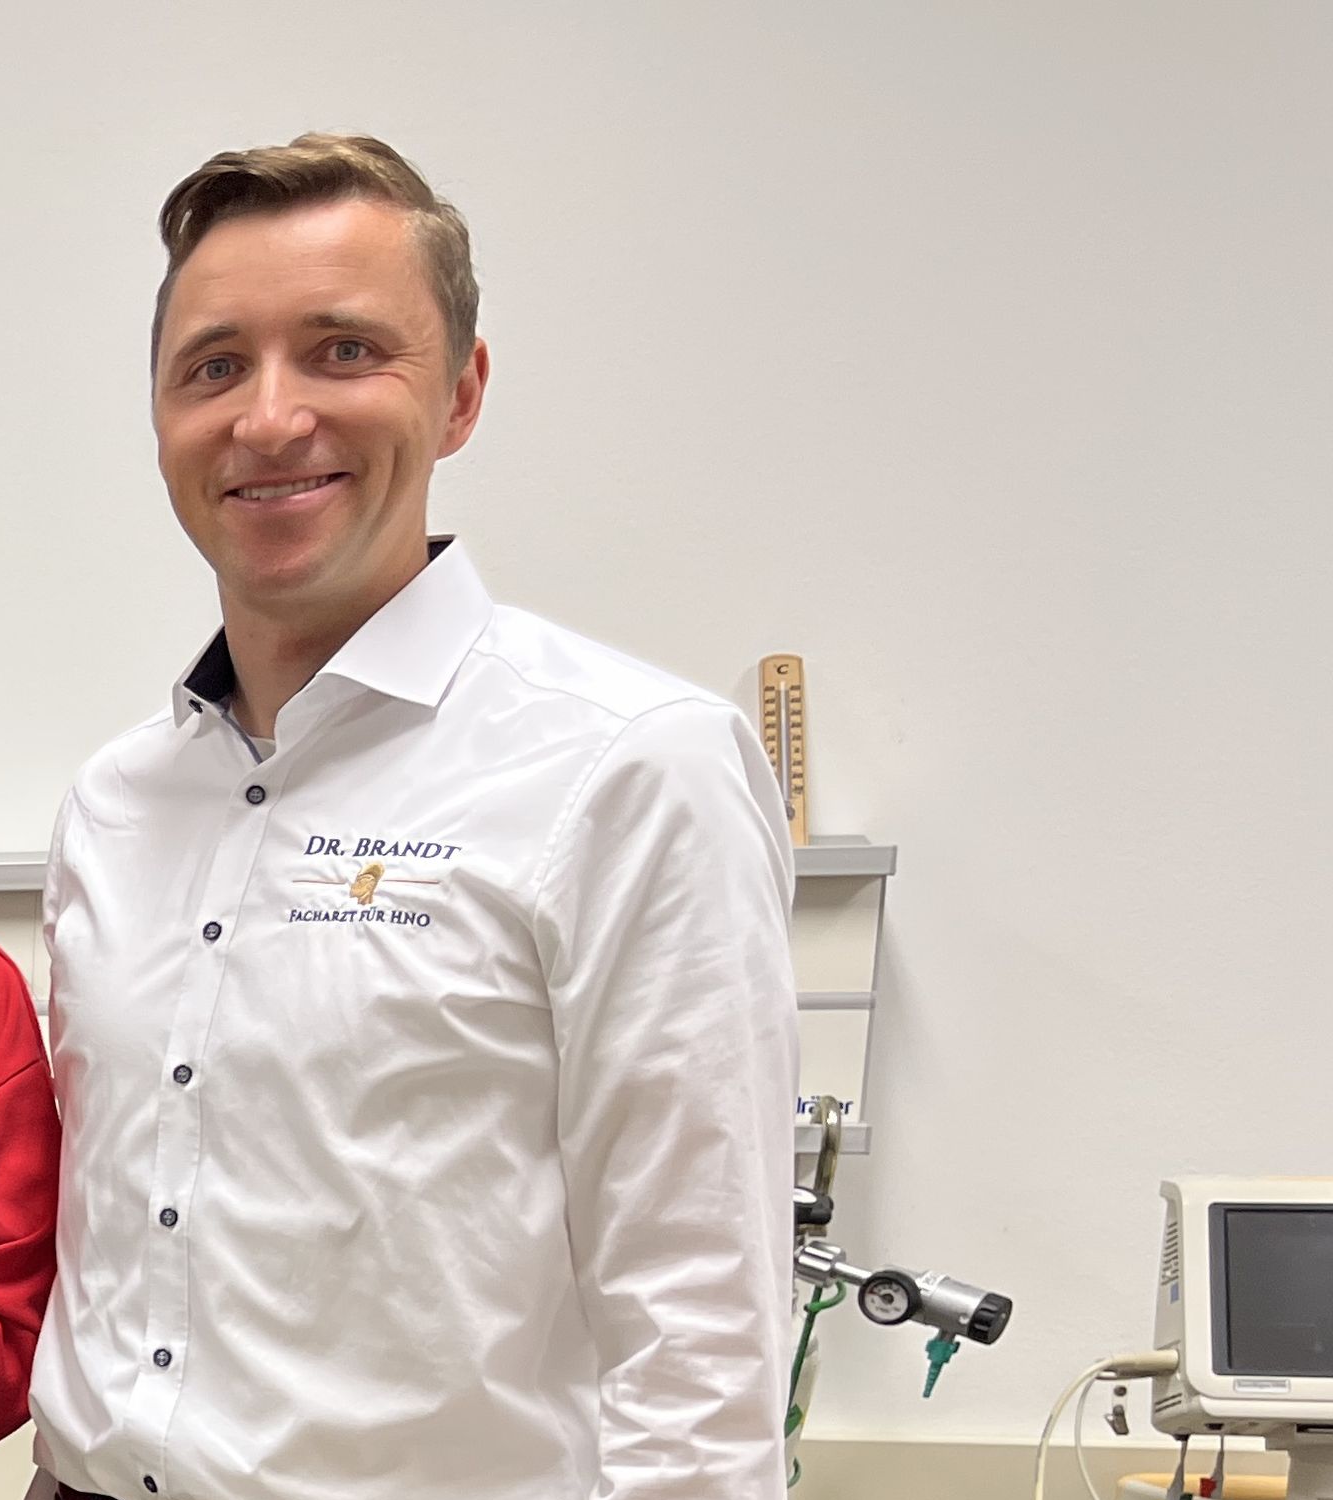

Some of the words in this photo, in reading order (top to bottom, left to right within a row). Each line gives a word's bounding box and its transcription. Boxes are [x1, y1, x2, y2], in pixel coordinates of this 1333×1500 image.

[353, 838, 462, 860] BRANDT
[289, 909, 357, 923] FACHARZT
[359, 906, 385, 922] FÜR
[391, 911, 431, 927] HNO
